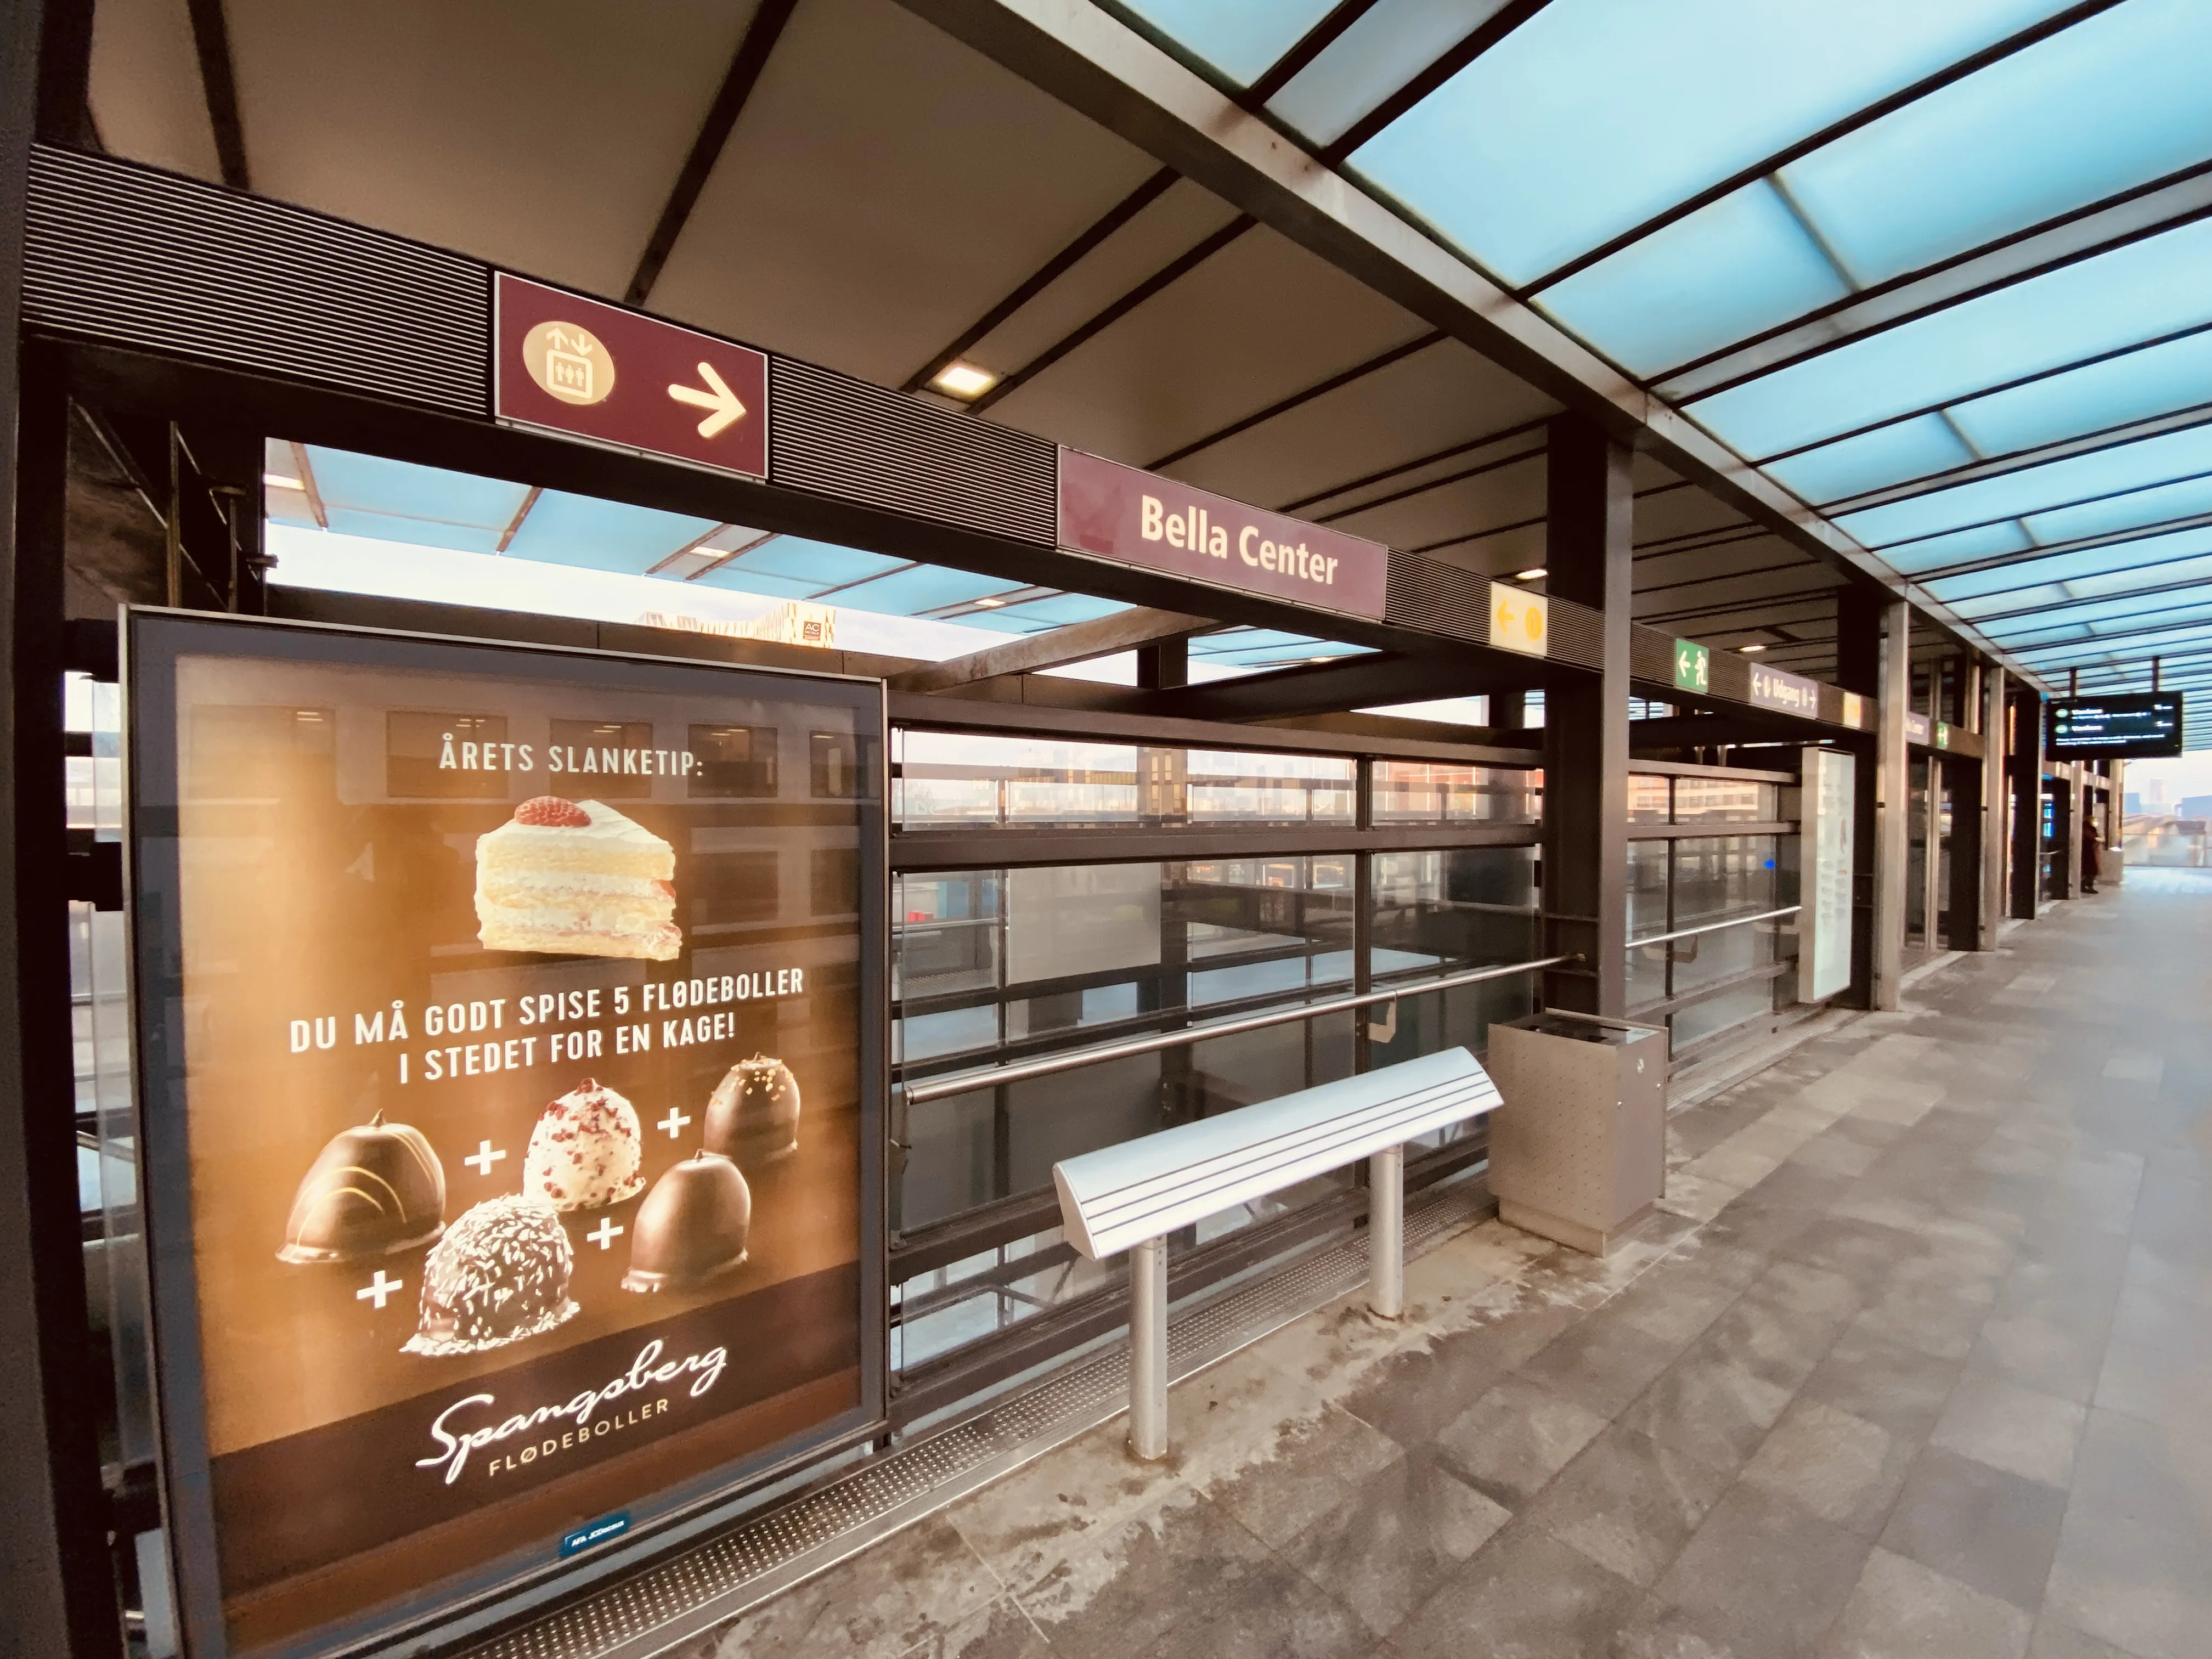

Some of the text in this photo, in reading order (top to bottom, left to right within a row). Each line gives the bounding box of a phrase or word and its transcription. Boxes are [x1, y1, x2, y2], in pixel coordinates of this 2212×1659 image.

[1141, 495, 1338, 585] Bella Center
[805, 623, 820, 631] AC
[1773, 678, 1799, 708] Udgang
[439, 732, 703, 777] ÅRETS SLANKETIP:
[290, 968, 803, 1053] DU MÅ GODT SPISE 5 FLØDEBOLLER
[400, 1012, 734, 1084] I STEDET FOR EN KAGE!
[415, 1339, 727, 1484] Spangsberg
[488, 1398, 669, 1476] FLØDEBOLLER
